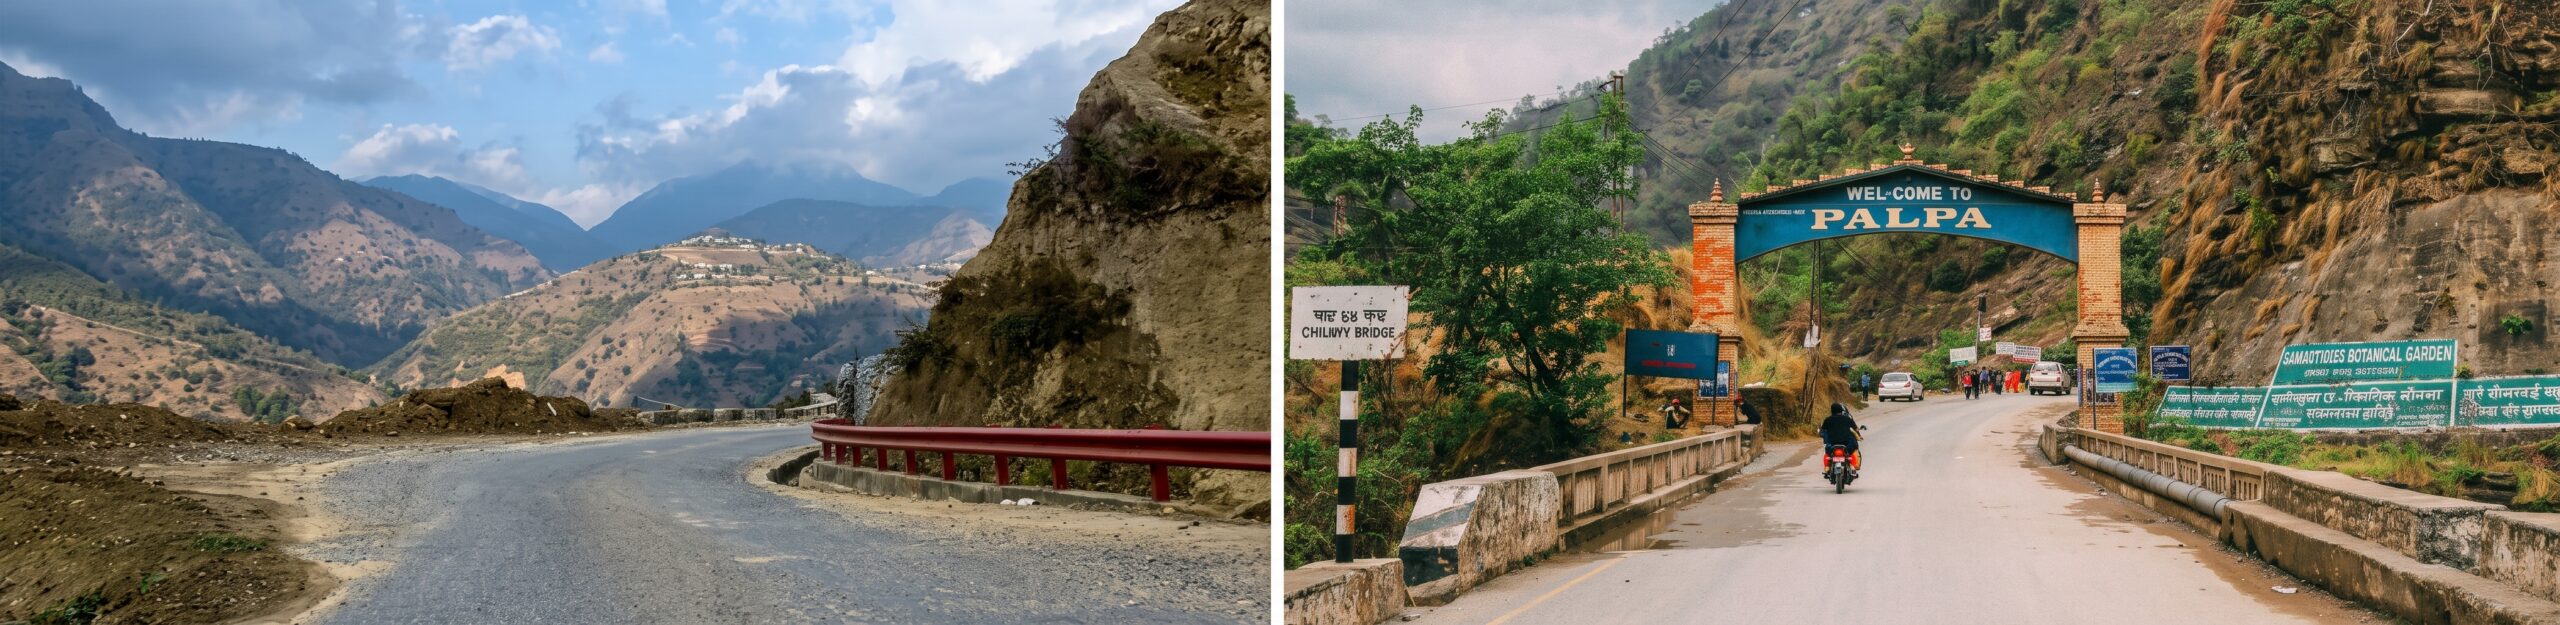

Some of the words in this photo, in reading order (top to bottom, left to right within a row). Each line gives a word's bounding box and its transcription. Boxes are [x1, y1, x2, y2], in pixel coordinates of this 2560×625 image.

[1949, 186, 1972, 200] TO
[1811, 207, 1992, 230] PALPA
[1354, 326, 1396, 339] BRIDGE
[2347, 346, 2403, 363] BOTANICAL
[2405, 345, 2453, 362] GARDEN
